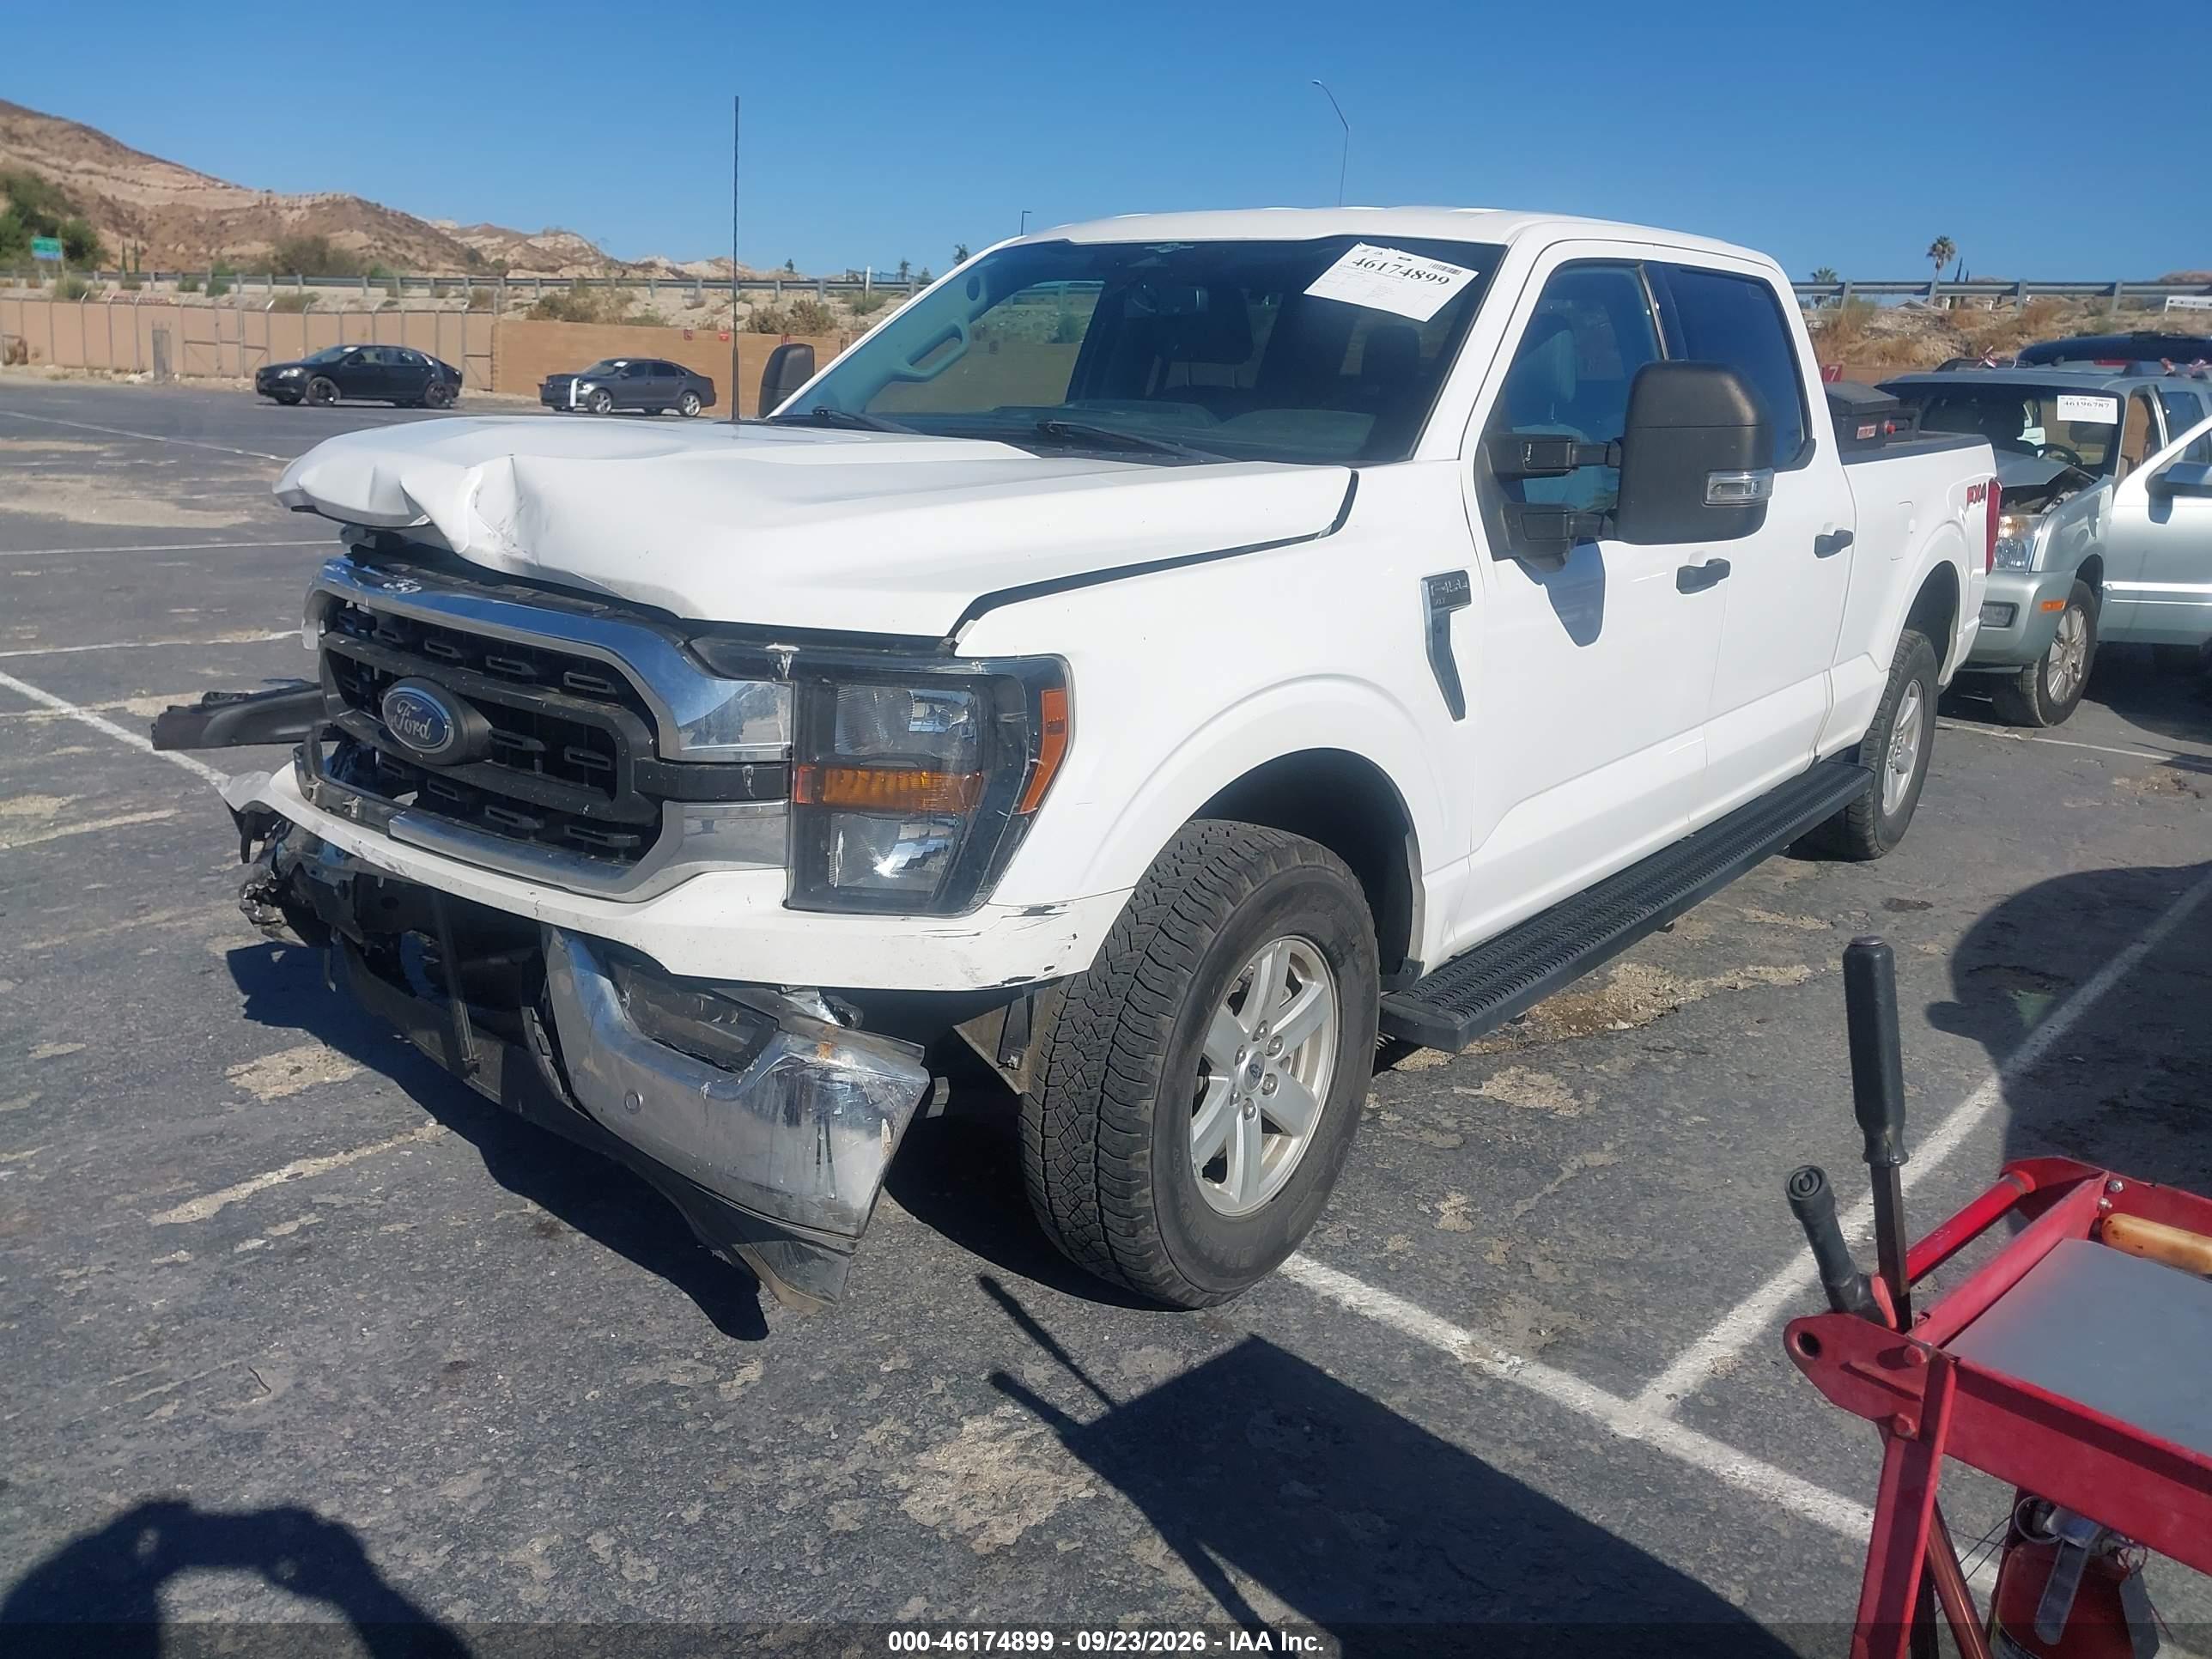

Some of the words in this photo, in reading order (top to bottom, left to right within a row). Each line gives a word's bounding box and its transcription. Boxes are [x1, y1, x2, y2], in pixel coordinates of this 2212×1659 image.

[1352, 257, 1450, 286] 46174899
[1829, 365, 1839, 382] 7
[393, 700, 432, 740] Ford
